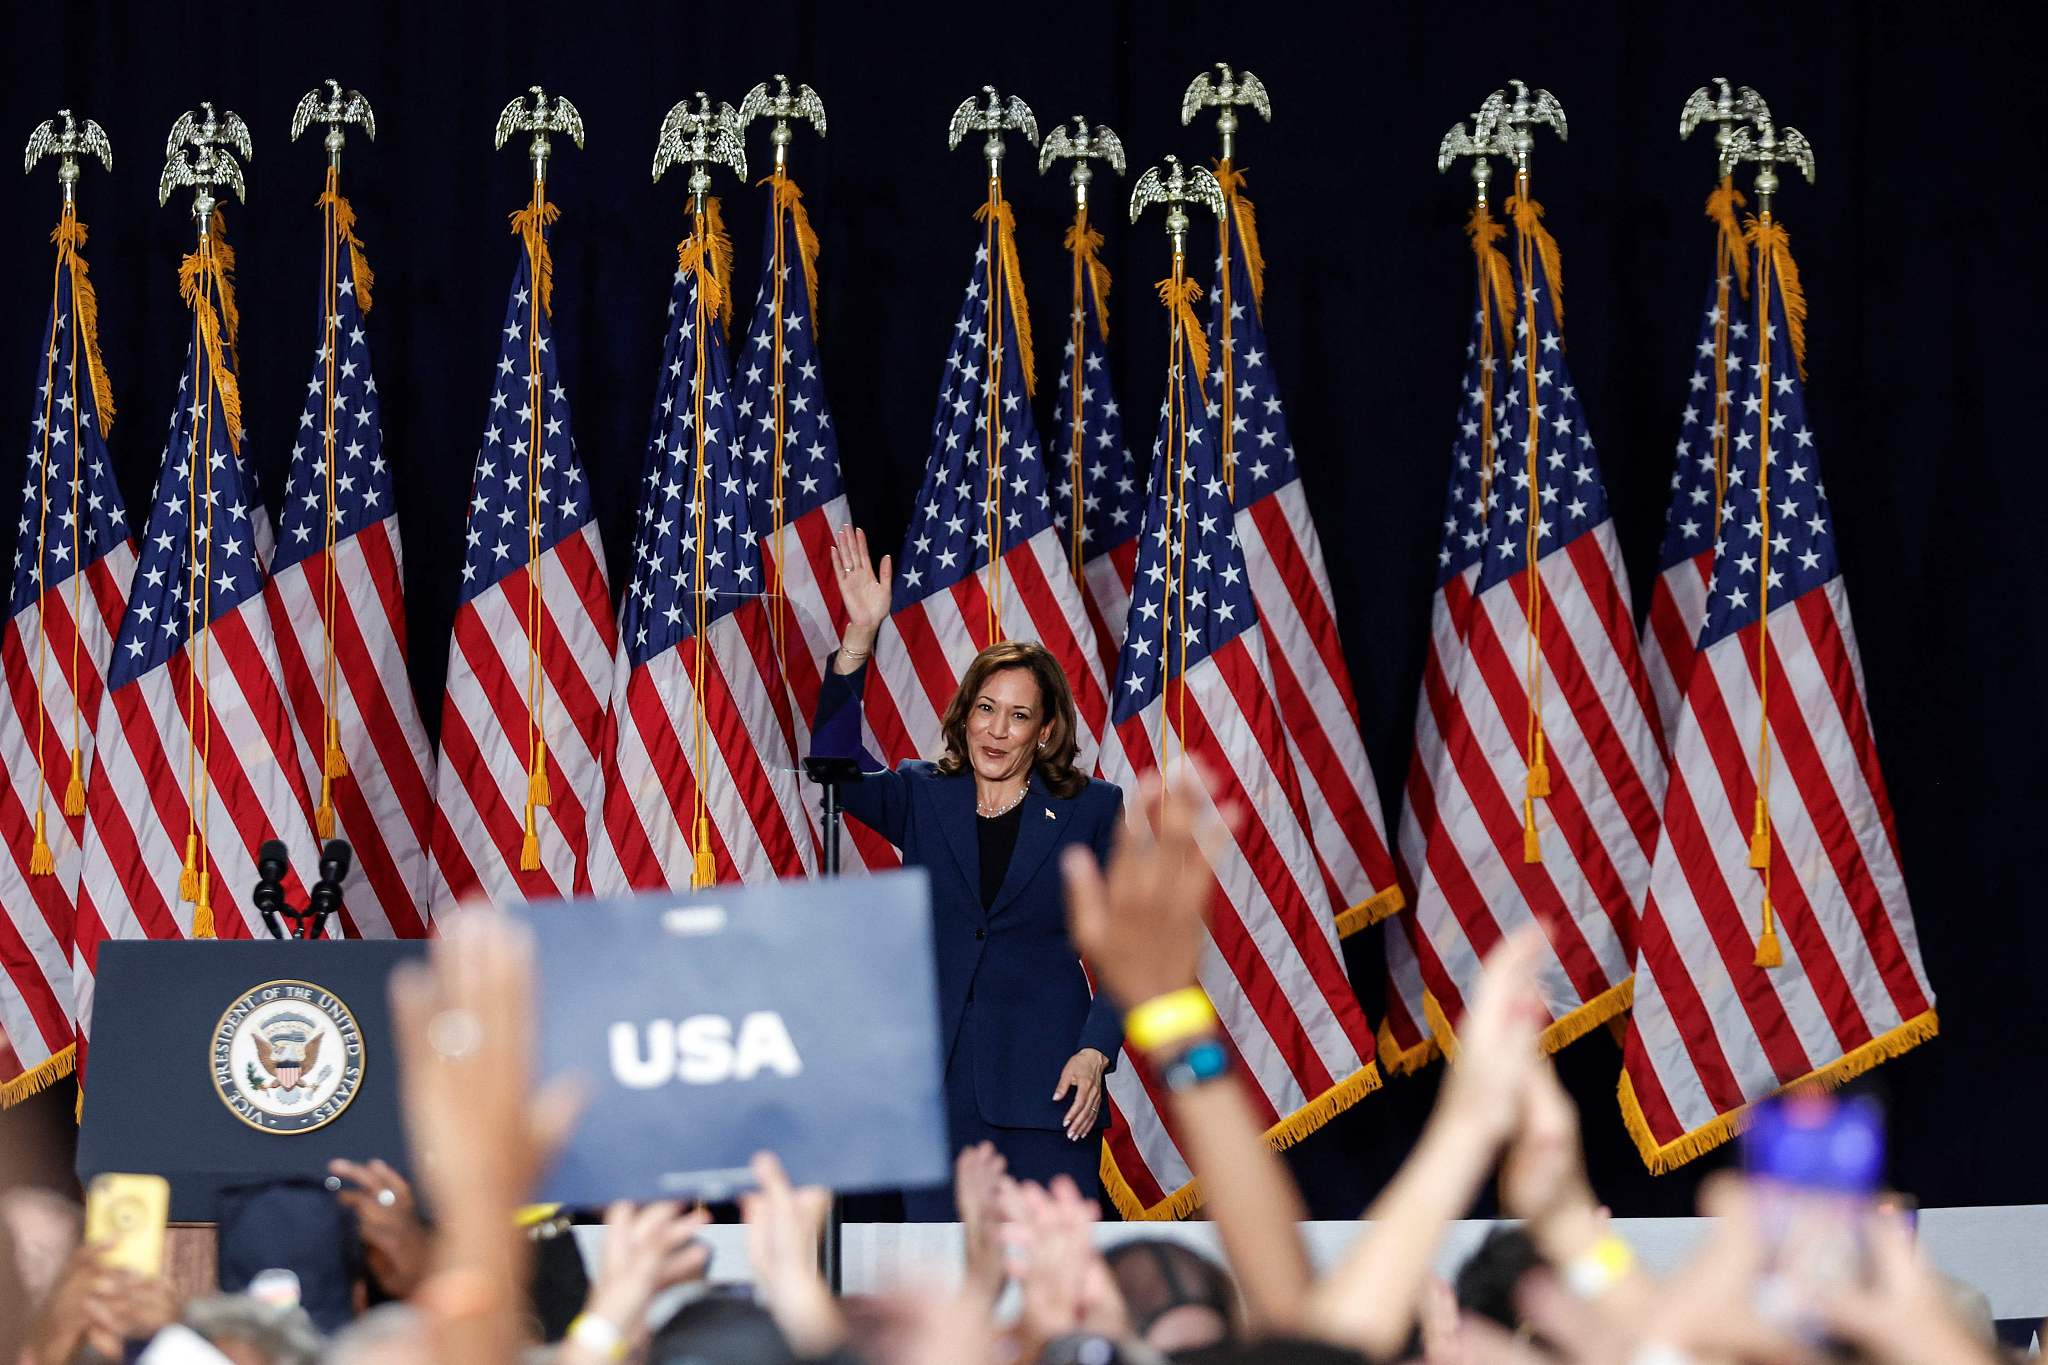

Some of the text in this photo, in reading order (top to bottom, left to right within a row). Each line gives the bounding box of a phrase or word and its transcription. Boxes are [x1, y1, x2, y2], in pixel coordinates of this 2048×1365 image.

[215, 986, 360, 1124] VICE PRESIDENT OF THE UNITED STATES
[607, 1010, 803, 1089] USA
